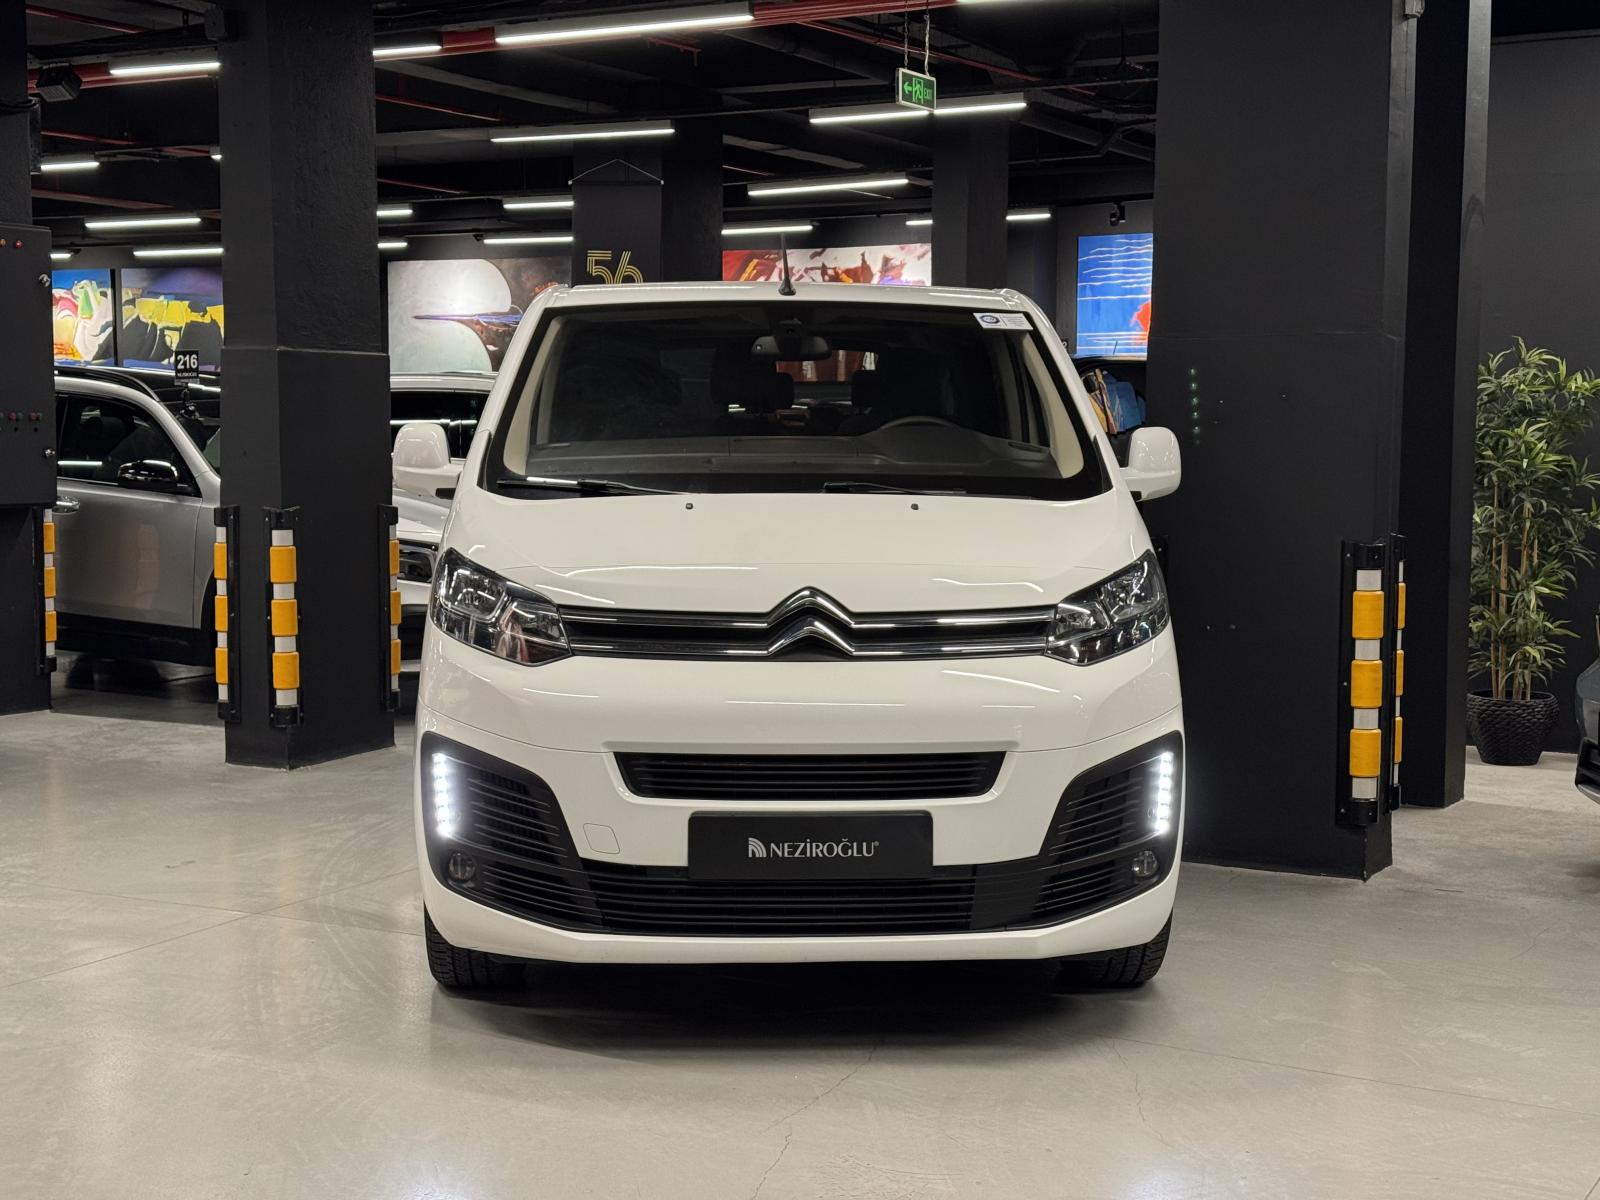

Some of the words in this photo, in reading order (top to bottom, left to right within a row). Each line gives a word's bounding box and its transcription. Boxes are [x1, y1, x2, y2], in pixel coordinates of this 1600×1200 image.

[923, 87, 933, 100] EXIT
[587, 250, 643, 284] 56
[177, 354, 198, 369] 216
[770, 838, 875, 858] NEZİROĞLU
